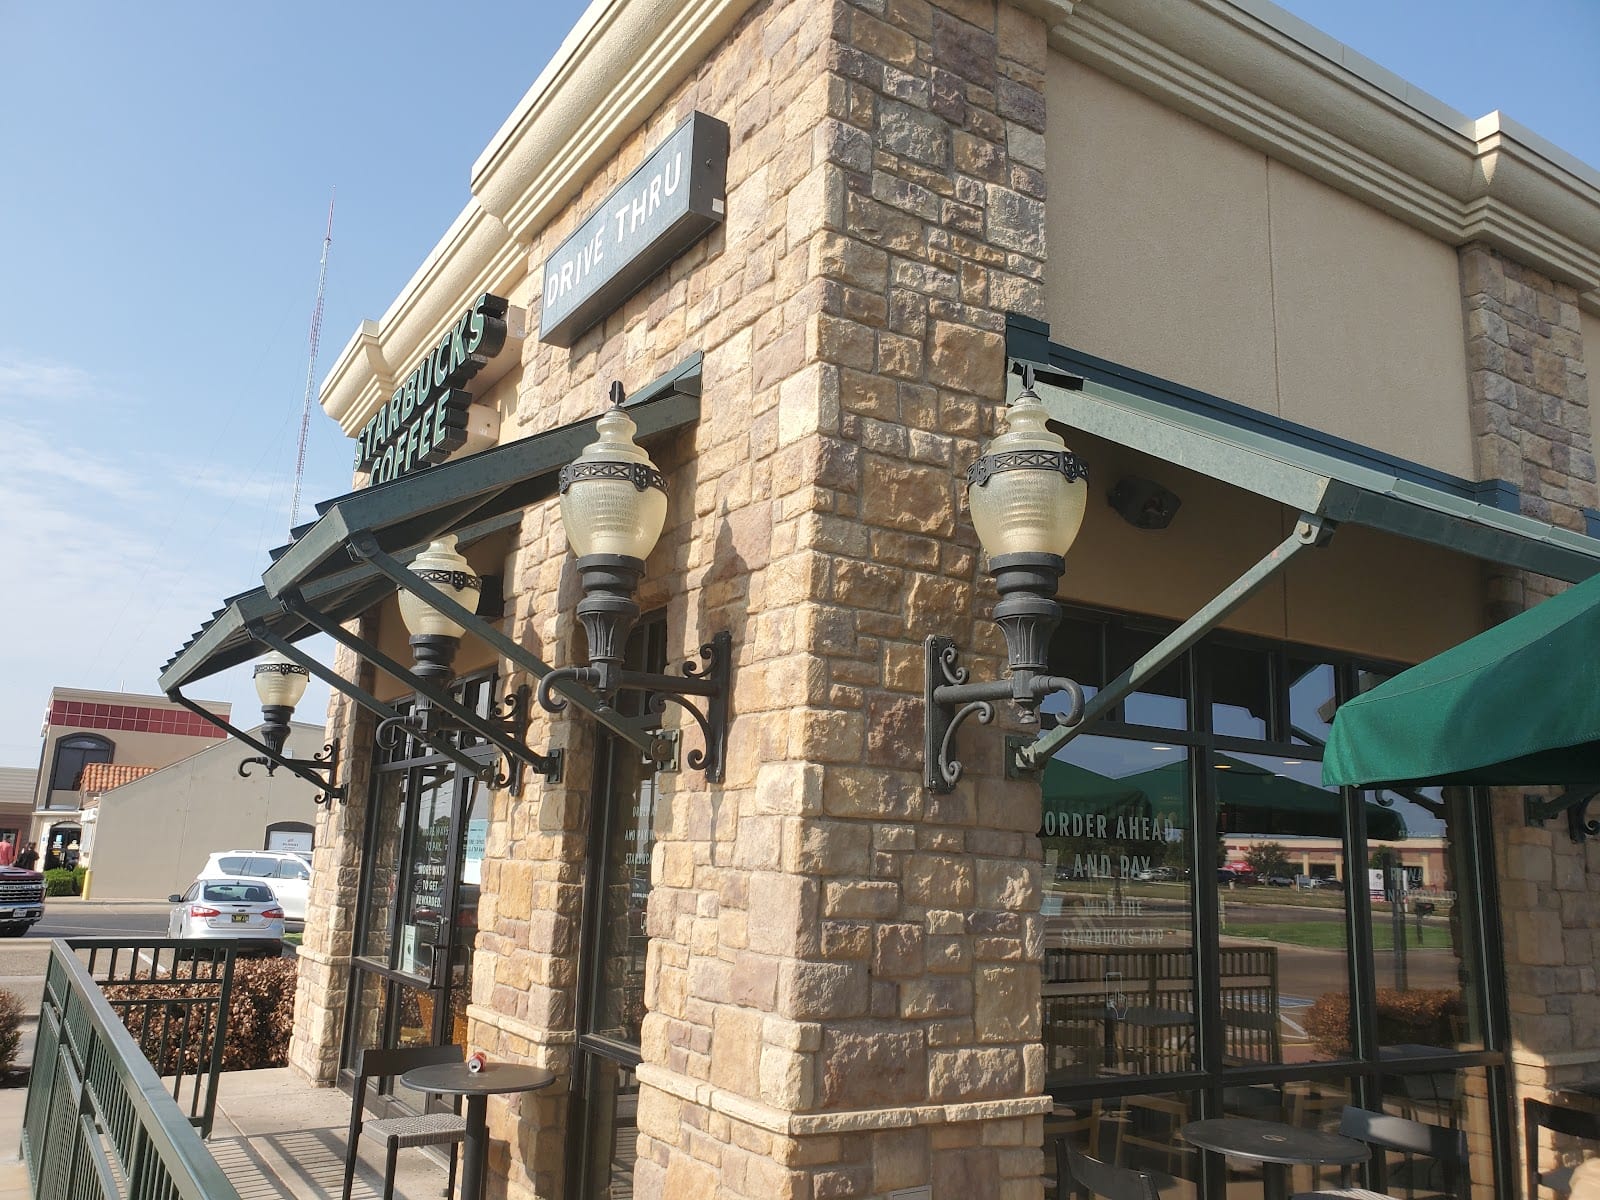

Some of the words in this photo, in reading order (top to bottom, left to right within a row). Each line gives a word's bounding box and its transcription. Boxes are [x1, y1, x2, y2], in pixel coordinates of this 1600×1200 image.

[547, 225, 605, 308] DRIVE
[615, 151, 682, 243] THRU
[353, 293, 488, 472] STARBUCKS
[369, 389, 451, 488] COFFEE
[1044, 811, 1107, 838] ORDER
[1115, 815, 1175, 842] AHEAD
[1073, 853, 1111, 879] AND
[1120, 855, 1150, 880] PAY
[422, 880, 429, 890] TO
[429, 880, 439, 891] GET
[1084, 899, 1115, 916] WITH
[1121, 900, 1143, 916] THE
[1062, 928, 1135, 946] STARBUCKS
[1141, 928, 1164, 945] APP
